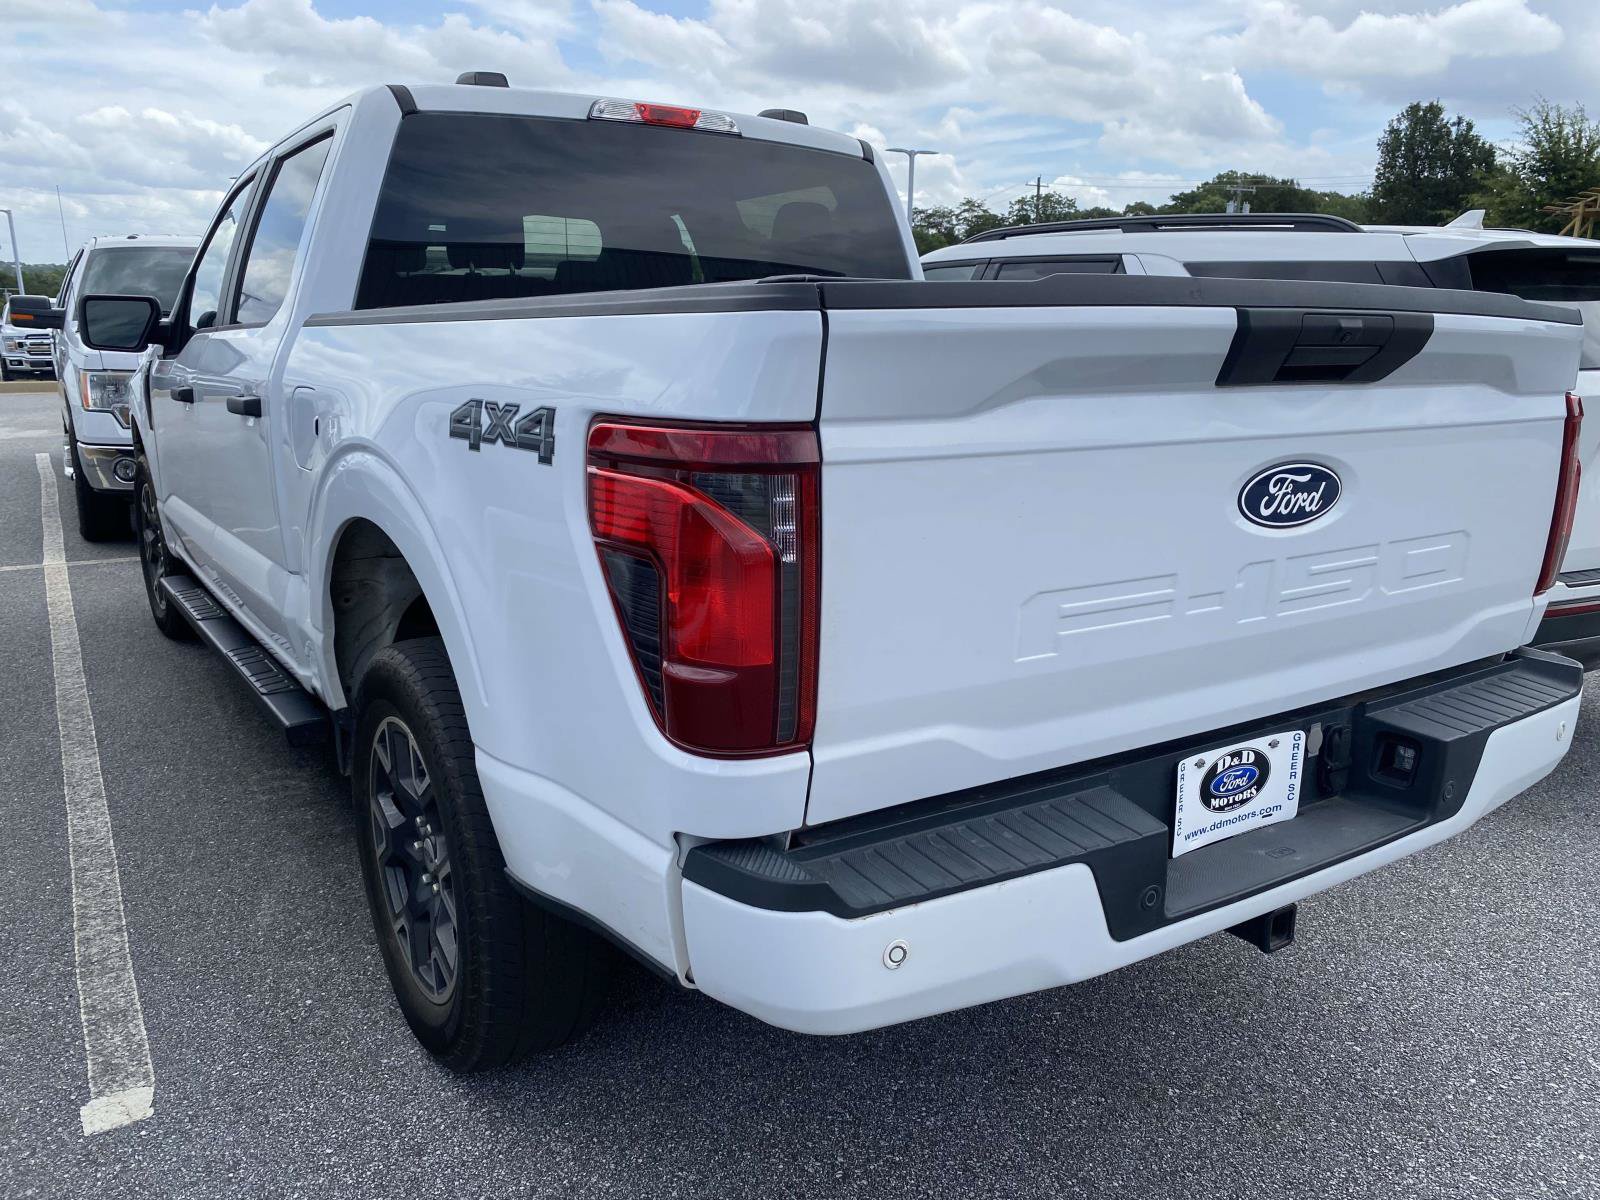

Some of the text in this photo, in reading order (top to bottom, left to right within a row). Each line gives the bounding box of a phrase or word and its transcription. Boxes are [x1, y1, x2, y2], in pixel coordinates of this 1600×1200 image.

[1260, 474, 1326, 516] Ford
[1014, 530, 1471, 661] F-150
[1216, 750, 1255, 774] D&D
[1220, 769, 1250, 792] Ford
[1287, 732, 1302, 801] GREER SC
[1176, 762, 1186, 837] GREER SC
[1210, 785, 1258, 810] MOTORS
[1184, 804, 1282, 841] www.ddmotors.com
